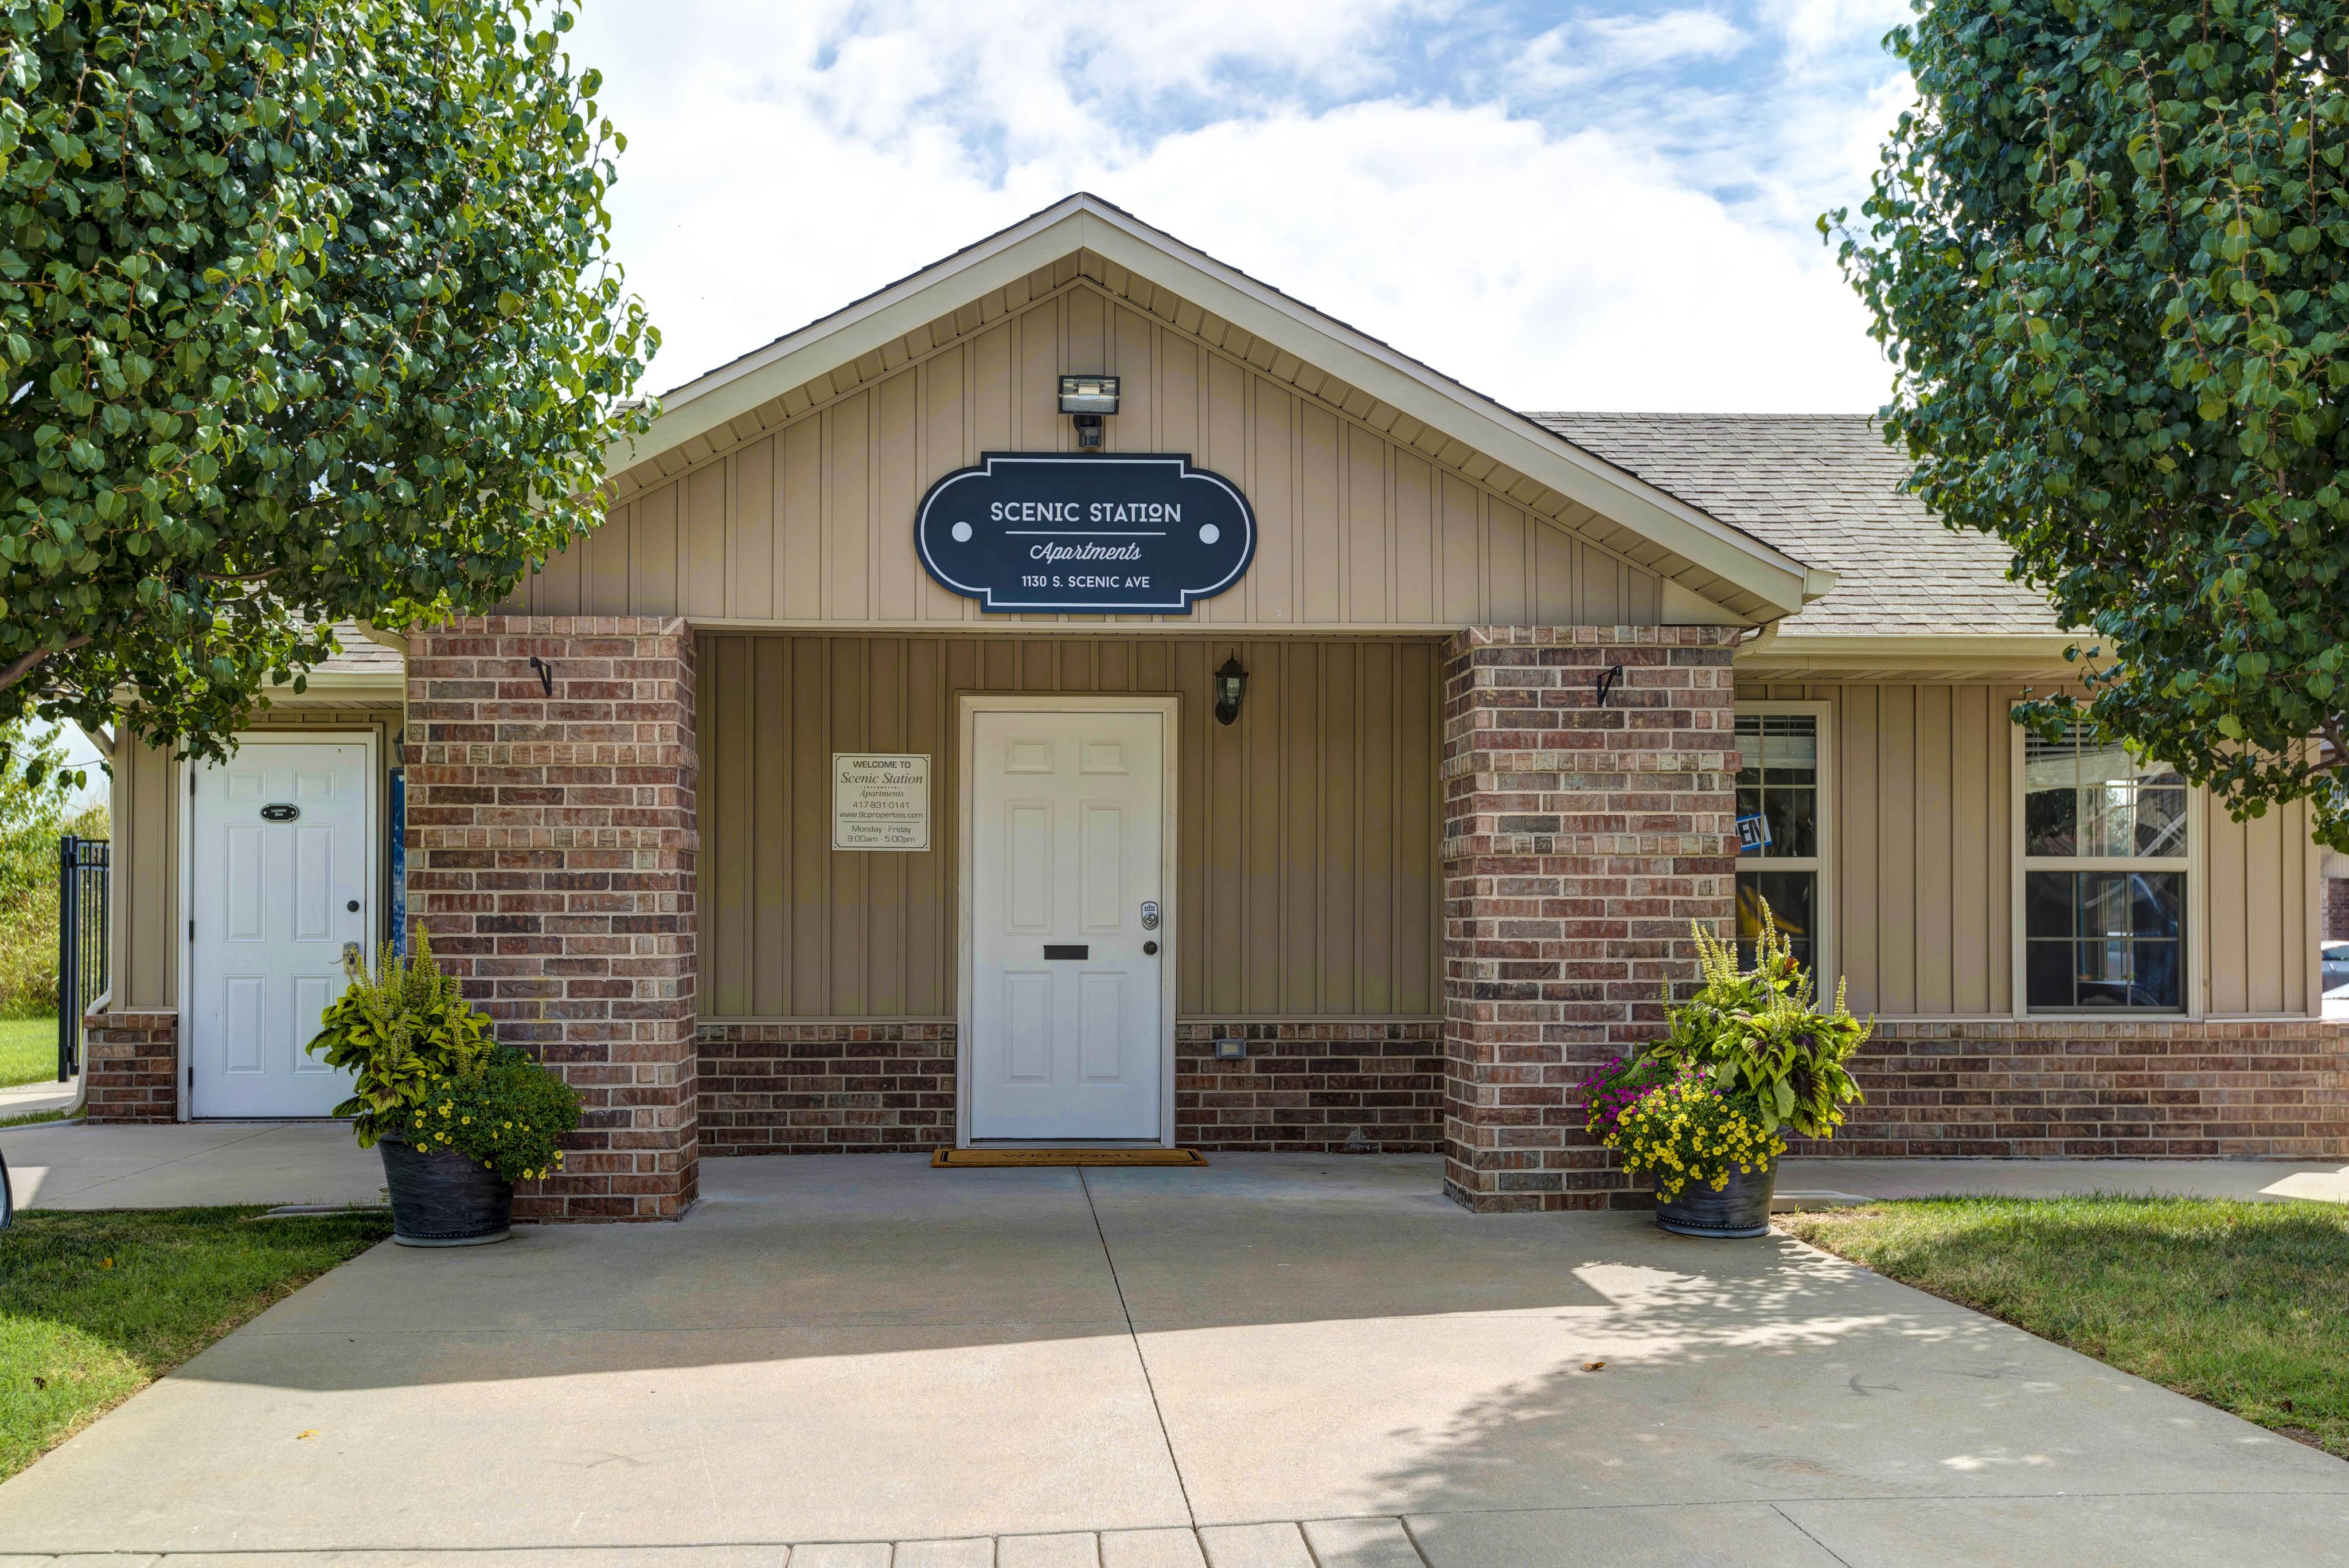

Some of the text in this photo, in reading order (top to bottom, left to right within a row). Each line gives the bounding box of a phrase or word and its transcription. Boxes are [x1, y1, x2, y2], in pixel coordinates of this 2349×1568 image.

[990, 502, 1181, 523] SCENIC STATION
[1030, 542, 1142, 564] Apartments
[1022, 576, 1150, 588] 1130 S. SCENIC AVE
[841, 772, 922, 784] Scenic Station
[860, 789, 904, 798] Apartments
[852, 826, 882, 834] Monday
[884, 836, 915, 844] 5:00pm
